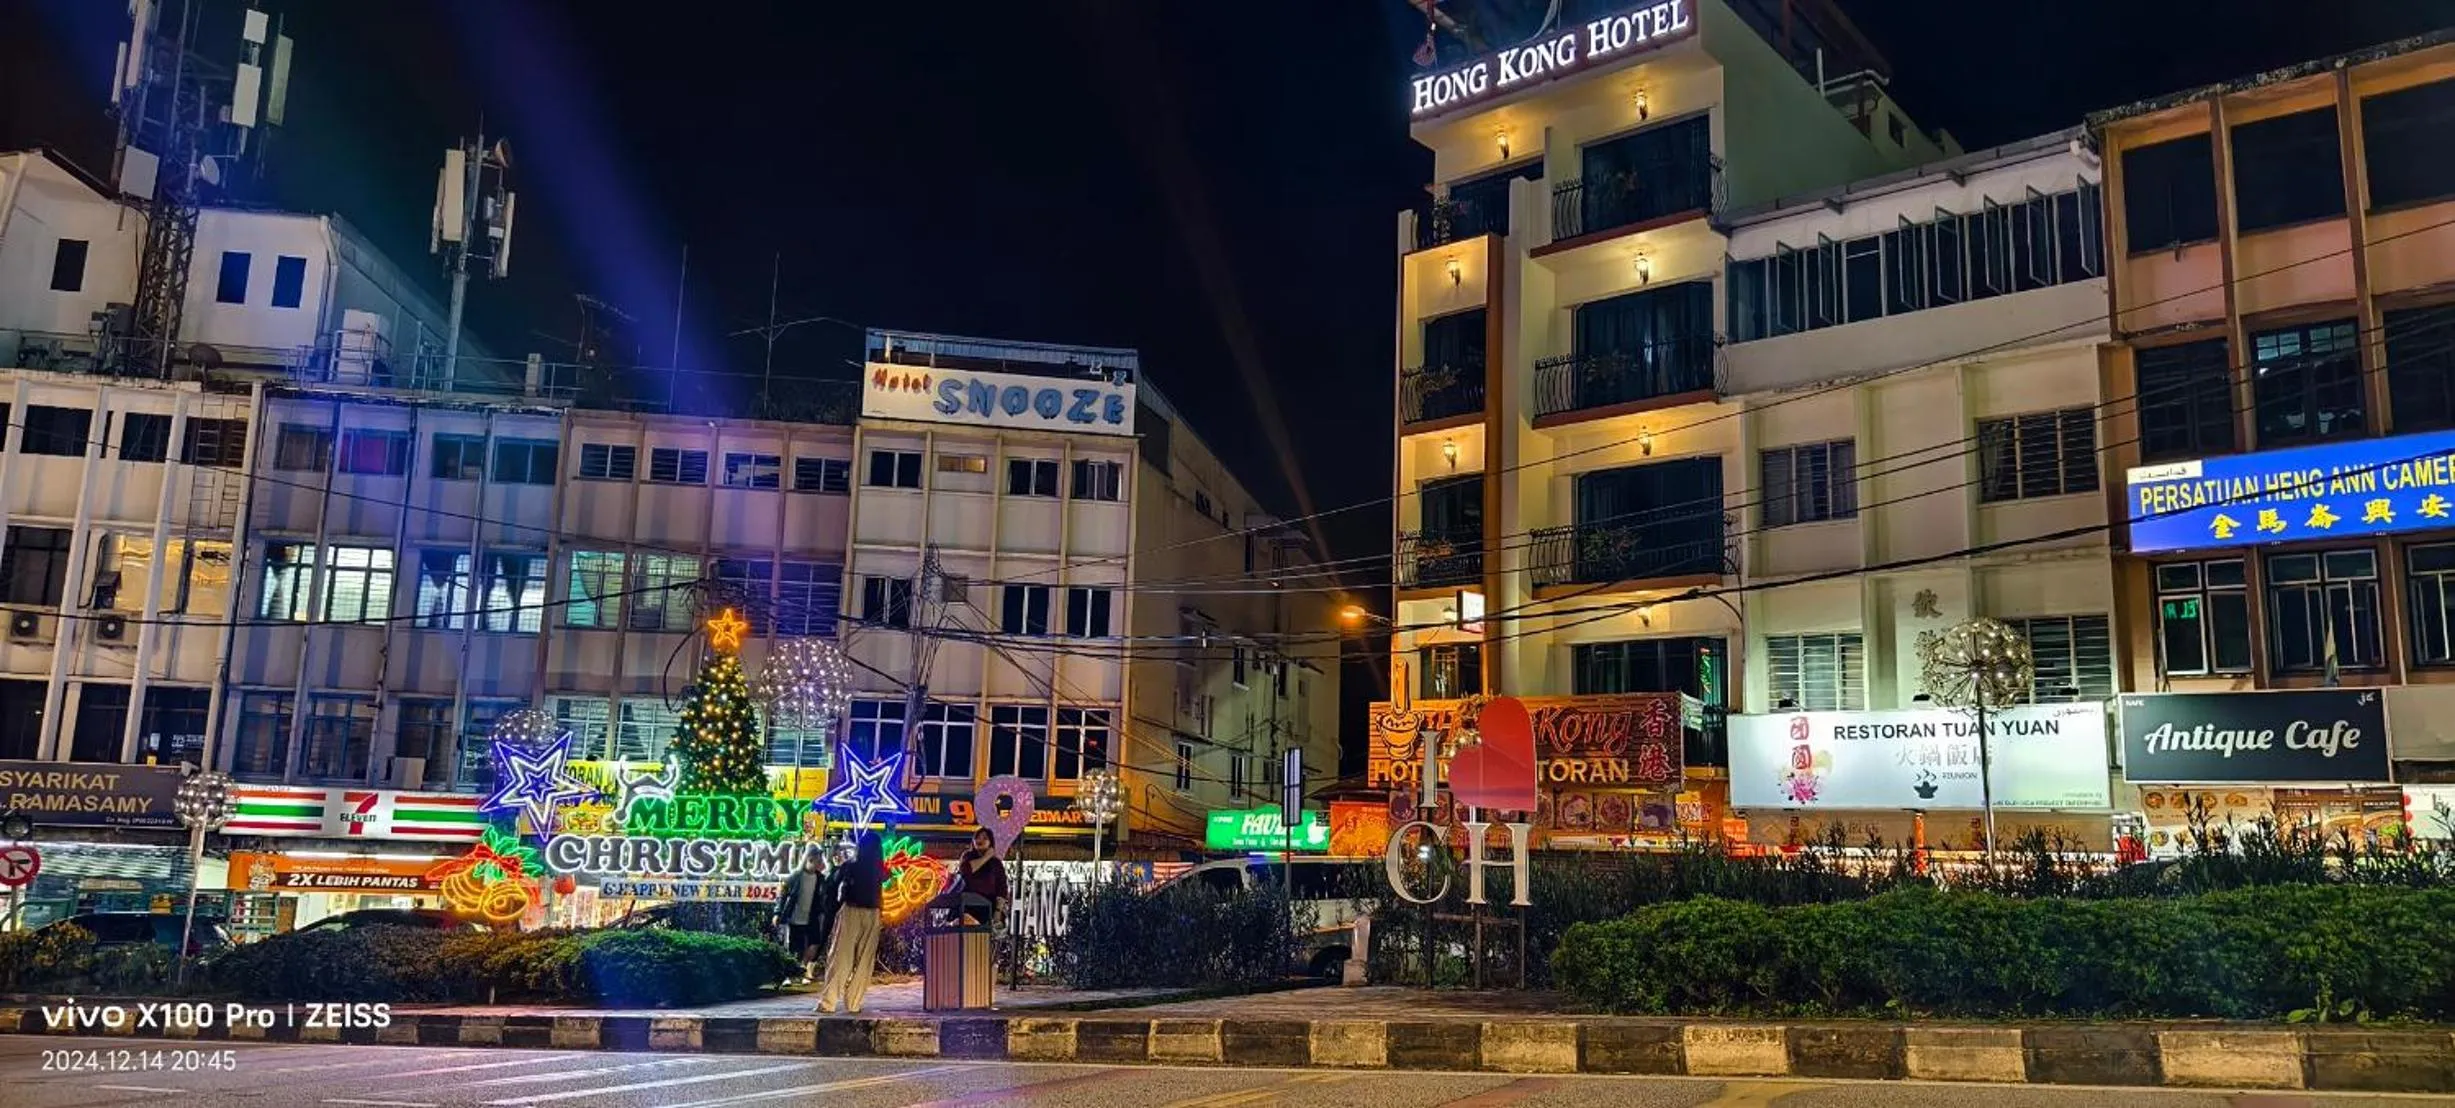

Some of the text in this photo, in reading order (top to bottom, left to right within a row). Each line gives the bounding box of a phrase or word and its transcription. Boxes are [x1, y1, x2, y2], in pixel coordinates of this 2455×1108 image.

[1411, 0, 1690, 113] HONG KONG HOTEL
[872, 368, 1126, 425] Hotel SNOOZE
[2139, 475, 2259, 516] PERSATUAN
[2264, 469, 2324, 503] HENG
[2329, 462, 2377, 497] ANN
[1834, 719, 2060, 740] RESTORAN TUAN YUAN
[2144, 719, 2361, 758] Antique Cafe
[0, 770, 120, 791] SYARIKAT
[1537, 757, 1629, 783] TORAN
[9, 793, 153, 813] RAMASAMY
[627, 795, 812, 833] MERRY
[287, 874, 312, 887] 2X
[316, 875, 358, 887] LEBIH
[361, 877, 419, 889] PANTAS
[617, 883, 665, 897] HAPPY
[671, 884, 700, 898] NEW
[706, 885, 742, 899] YEAR
[745, 886, 777, 899] 2025
